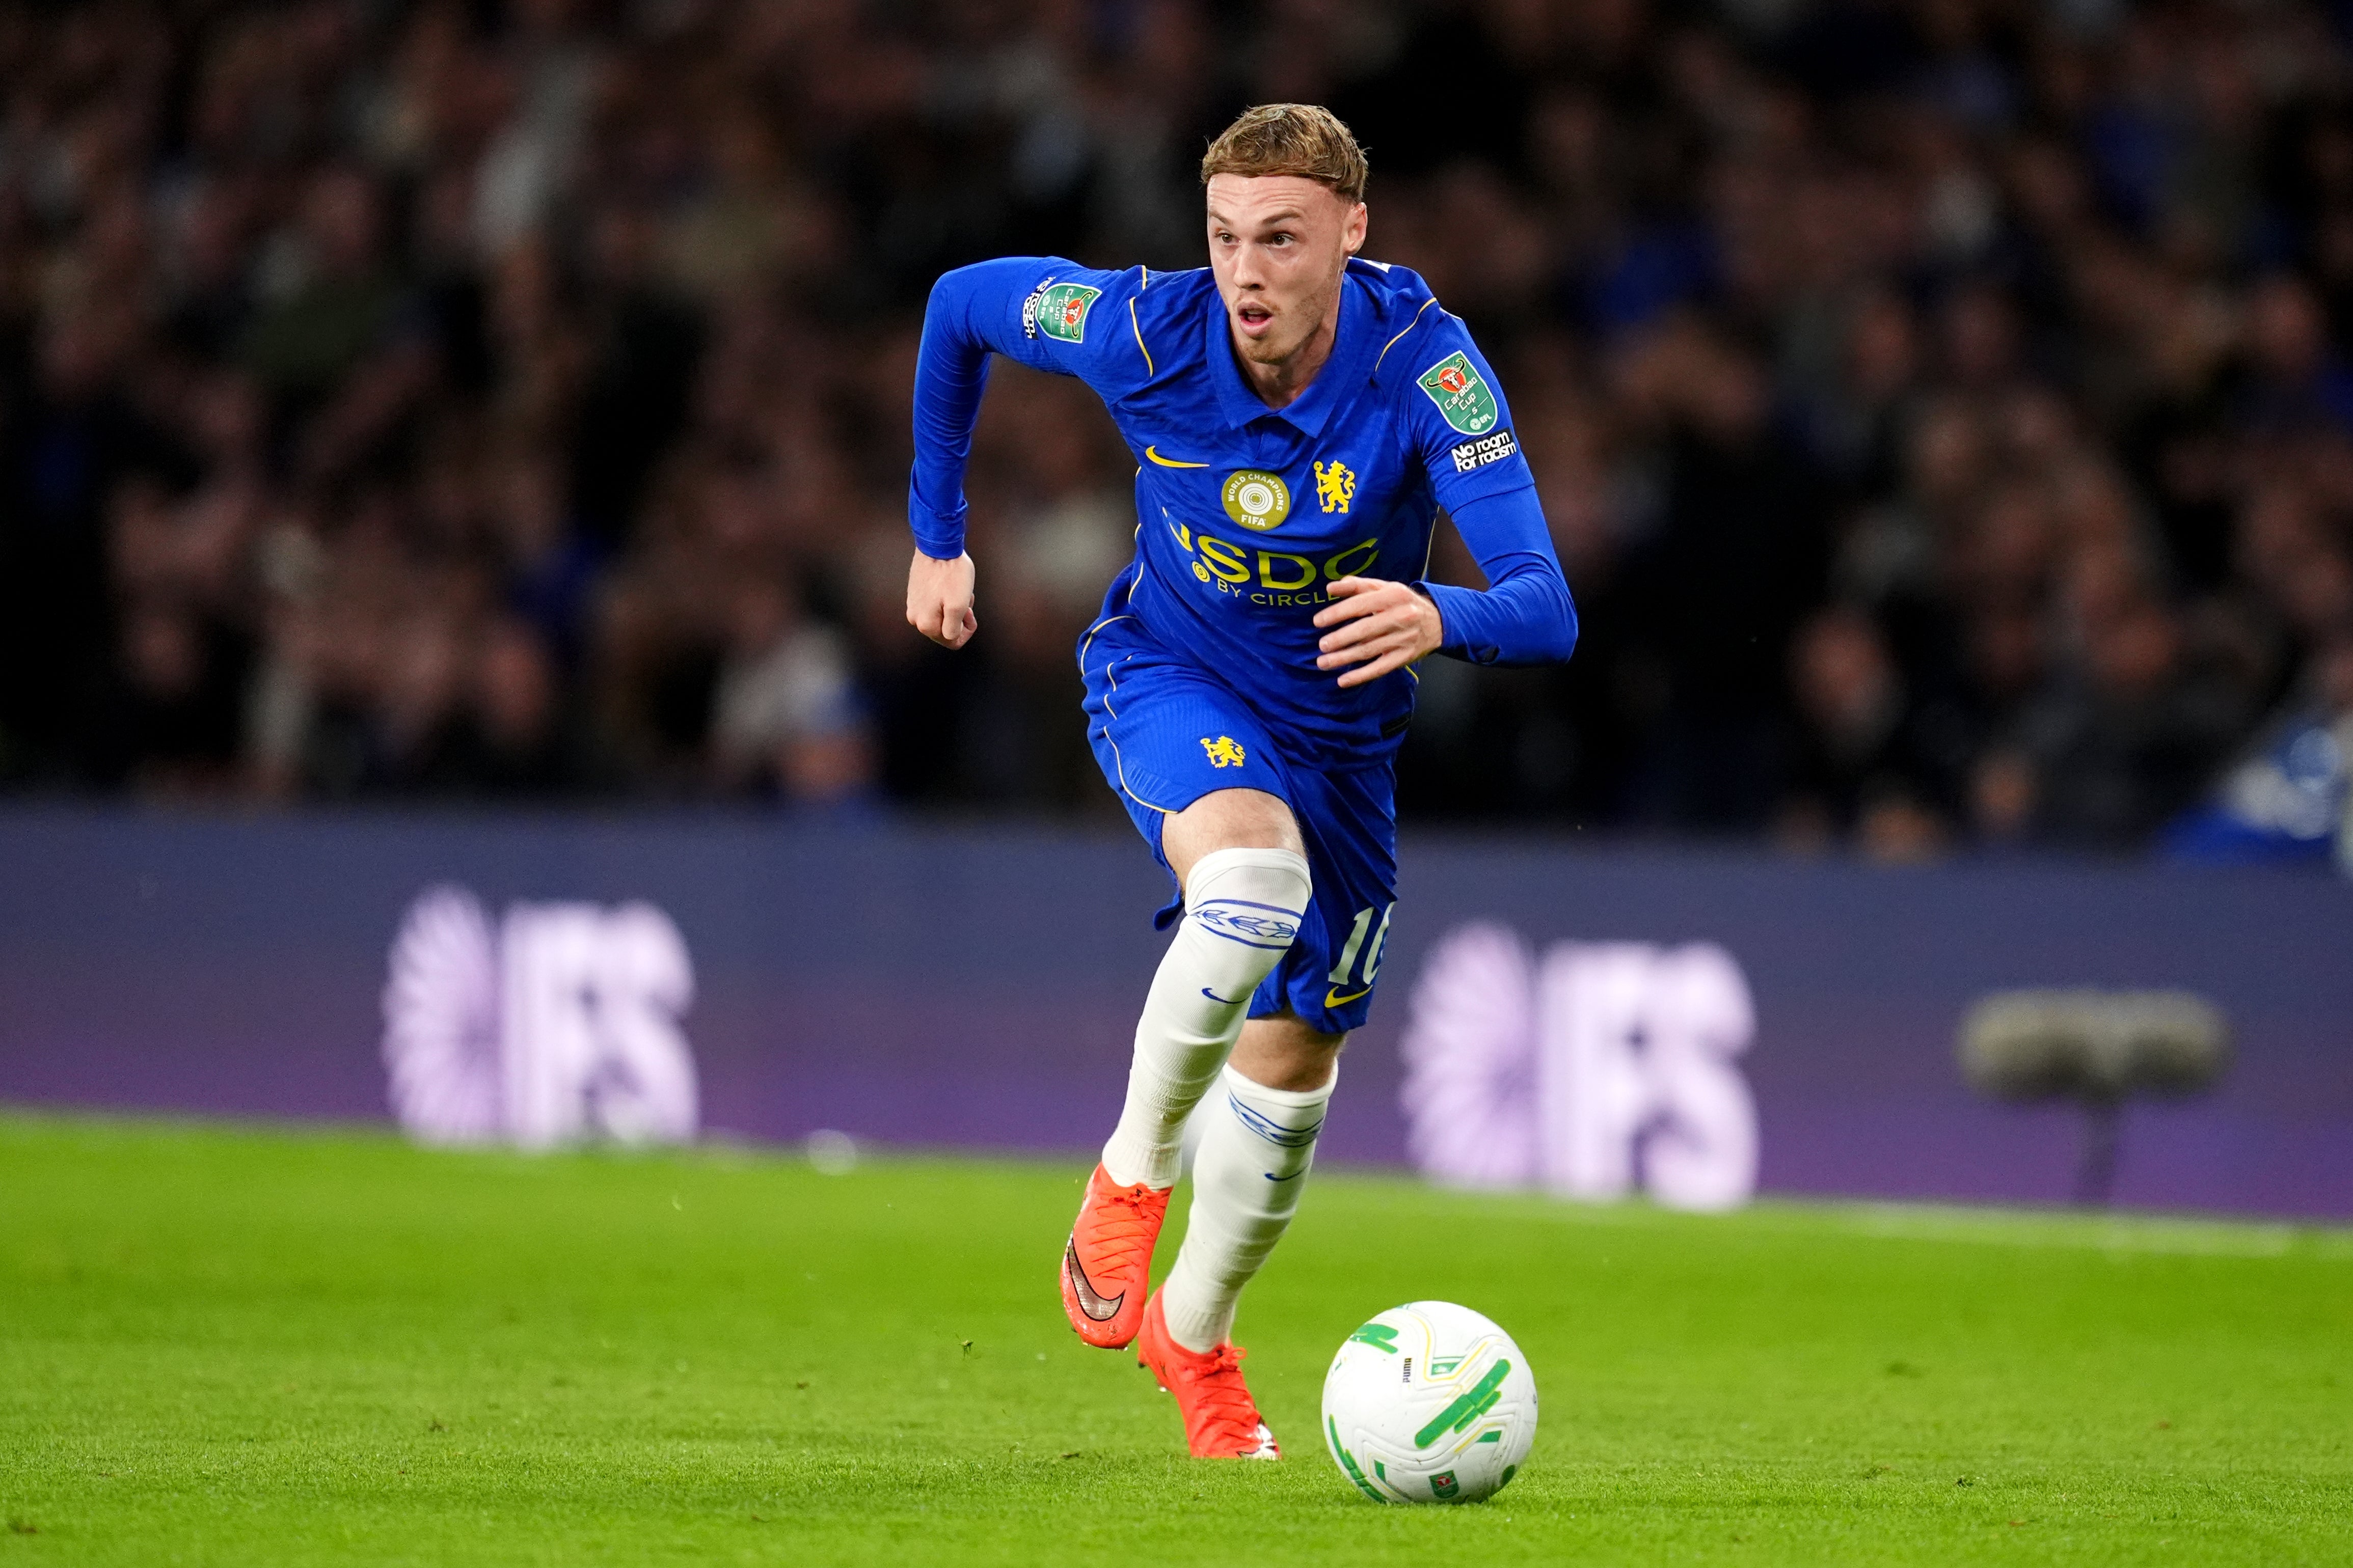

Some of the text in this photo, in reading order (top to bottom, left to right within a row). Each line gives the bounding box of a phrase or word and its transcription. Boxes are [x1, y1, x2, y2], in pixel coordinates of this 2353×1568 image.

[1054, 299, 1064, 320] Cup
[1060, 288, 1074, 335] Carabao
[1444, 376, 1478, 410] Carabao
[1458, 392, 1477, 411] Cup
[1479, 413, 1493, 424] EFL
[1451, 431, 1510, 462] No room
[1455, 442, 1517, 473] for racism
[1228, 473, 1284, 512] WORLD CHAMPIONS
[1240, 514, 1266, 527] FIFA
[1217, 577, 1241, 598] BY
[1402, 1358, 1412, 1383] PUMA
